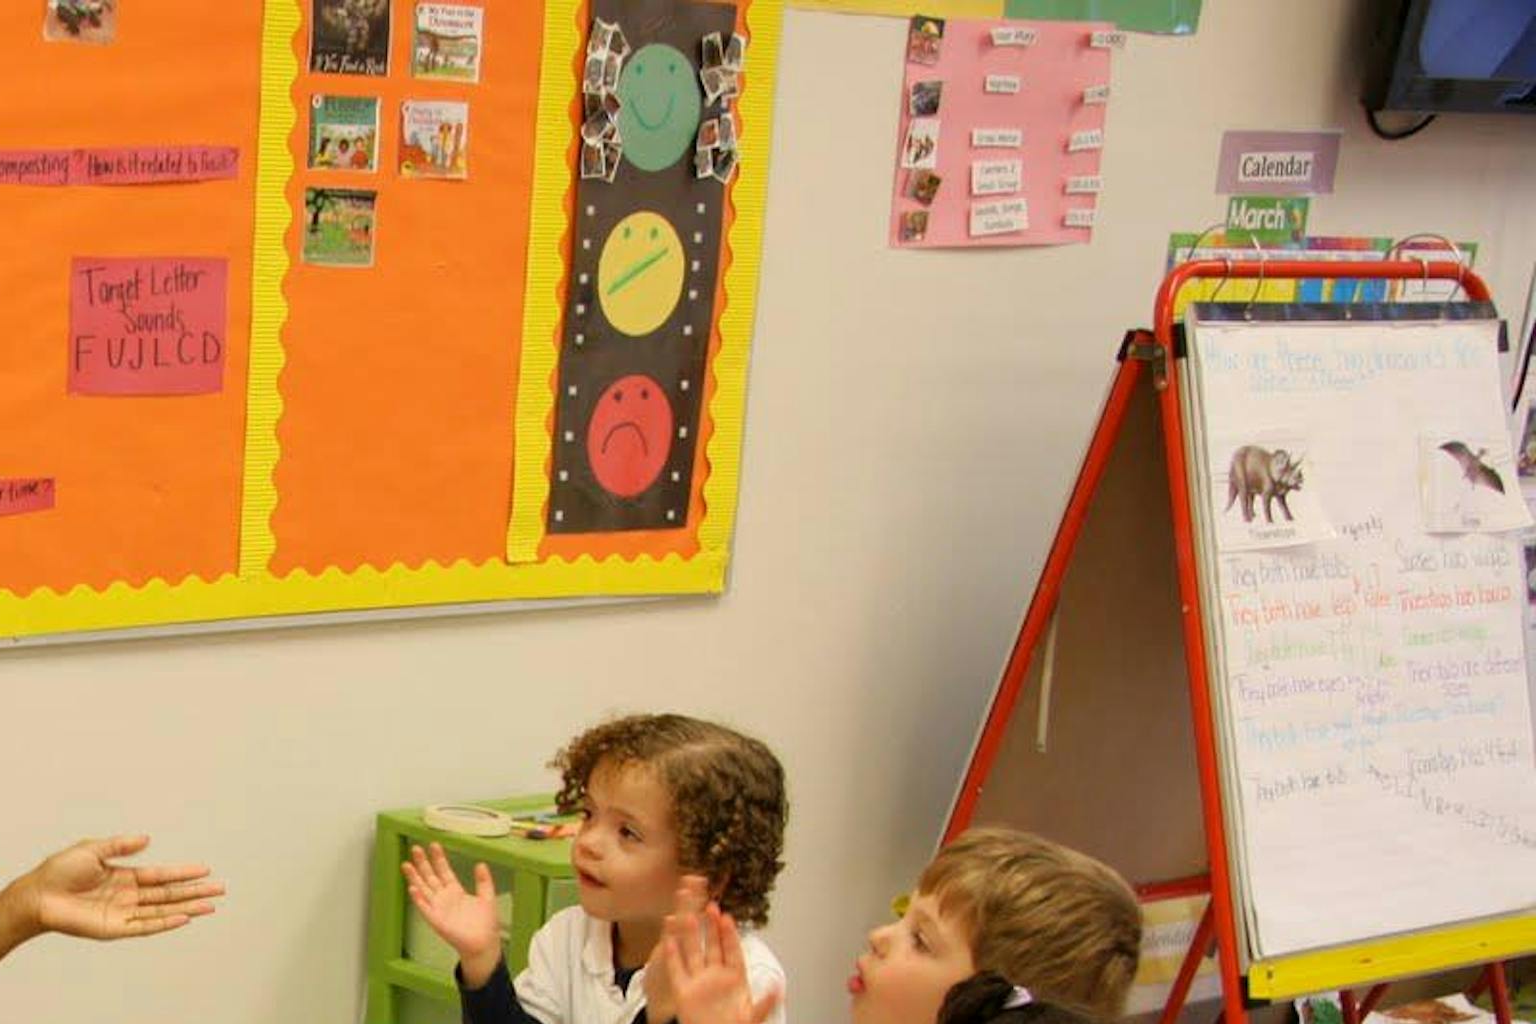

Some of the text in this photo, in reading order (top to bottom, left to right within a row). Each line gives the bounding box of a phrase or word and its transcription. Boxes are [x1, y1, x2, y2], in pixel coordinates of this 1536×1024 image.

[88, 153, 112, 178] How
[1241, 156, 1310, 178] Calendar
[1229, 200, 1286, 230] March
[79, 264, 206, 311] Target Letter
[121, 303, 185, 334] Sounds
